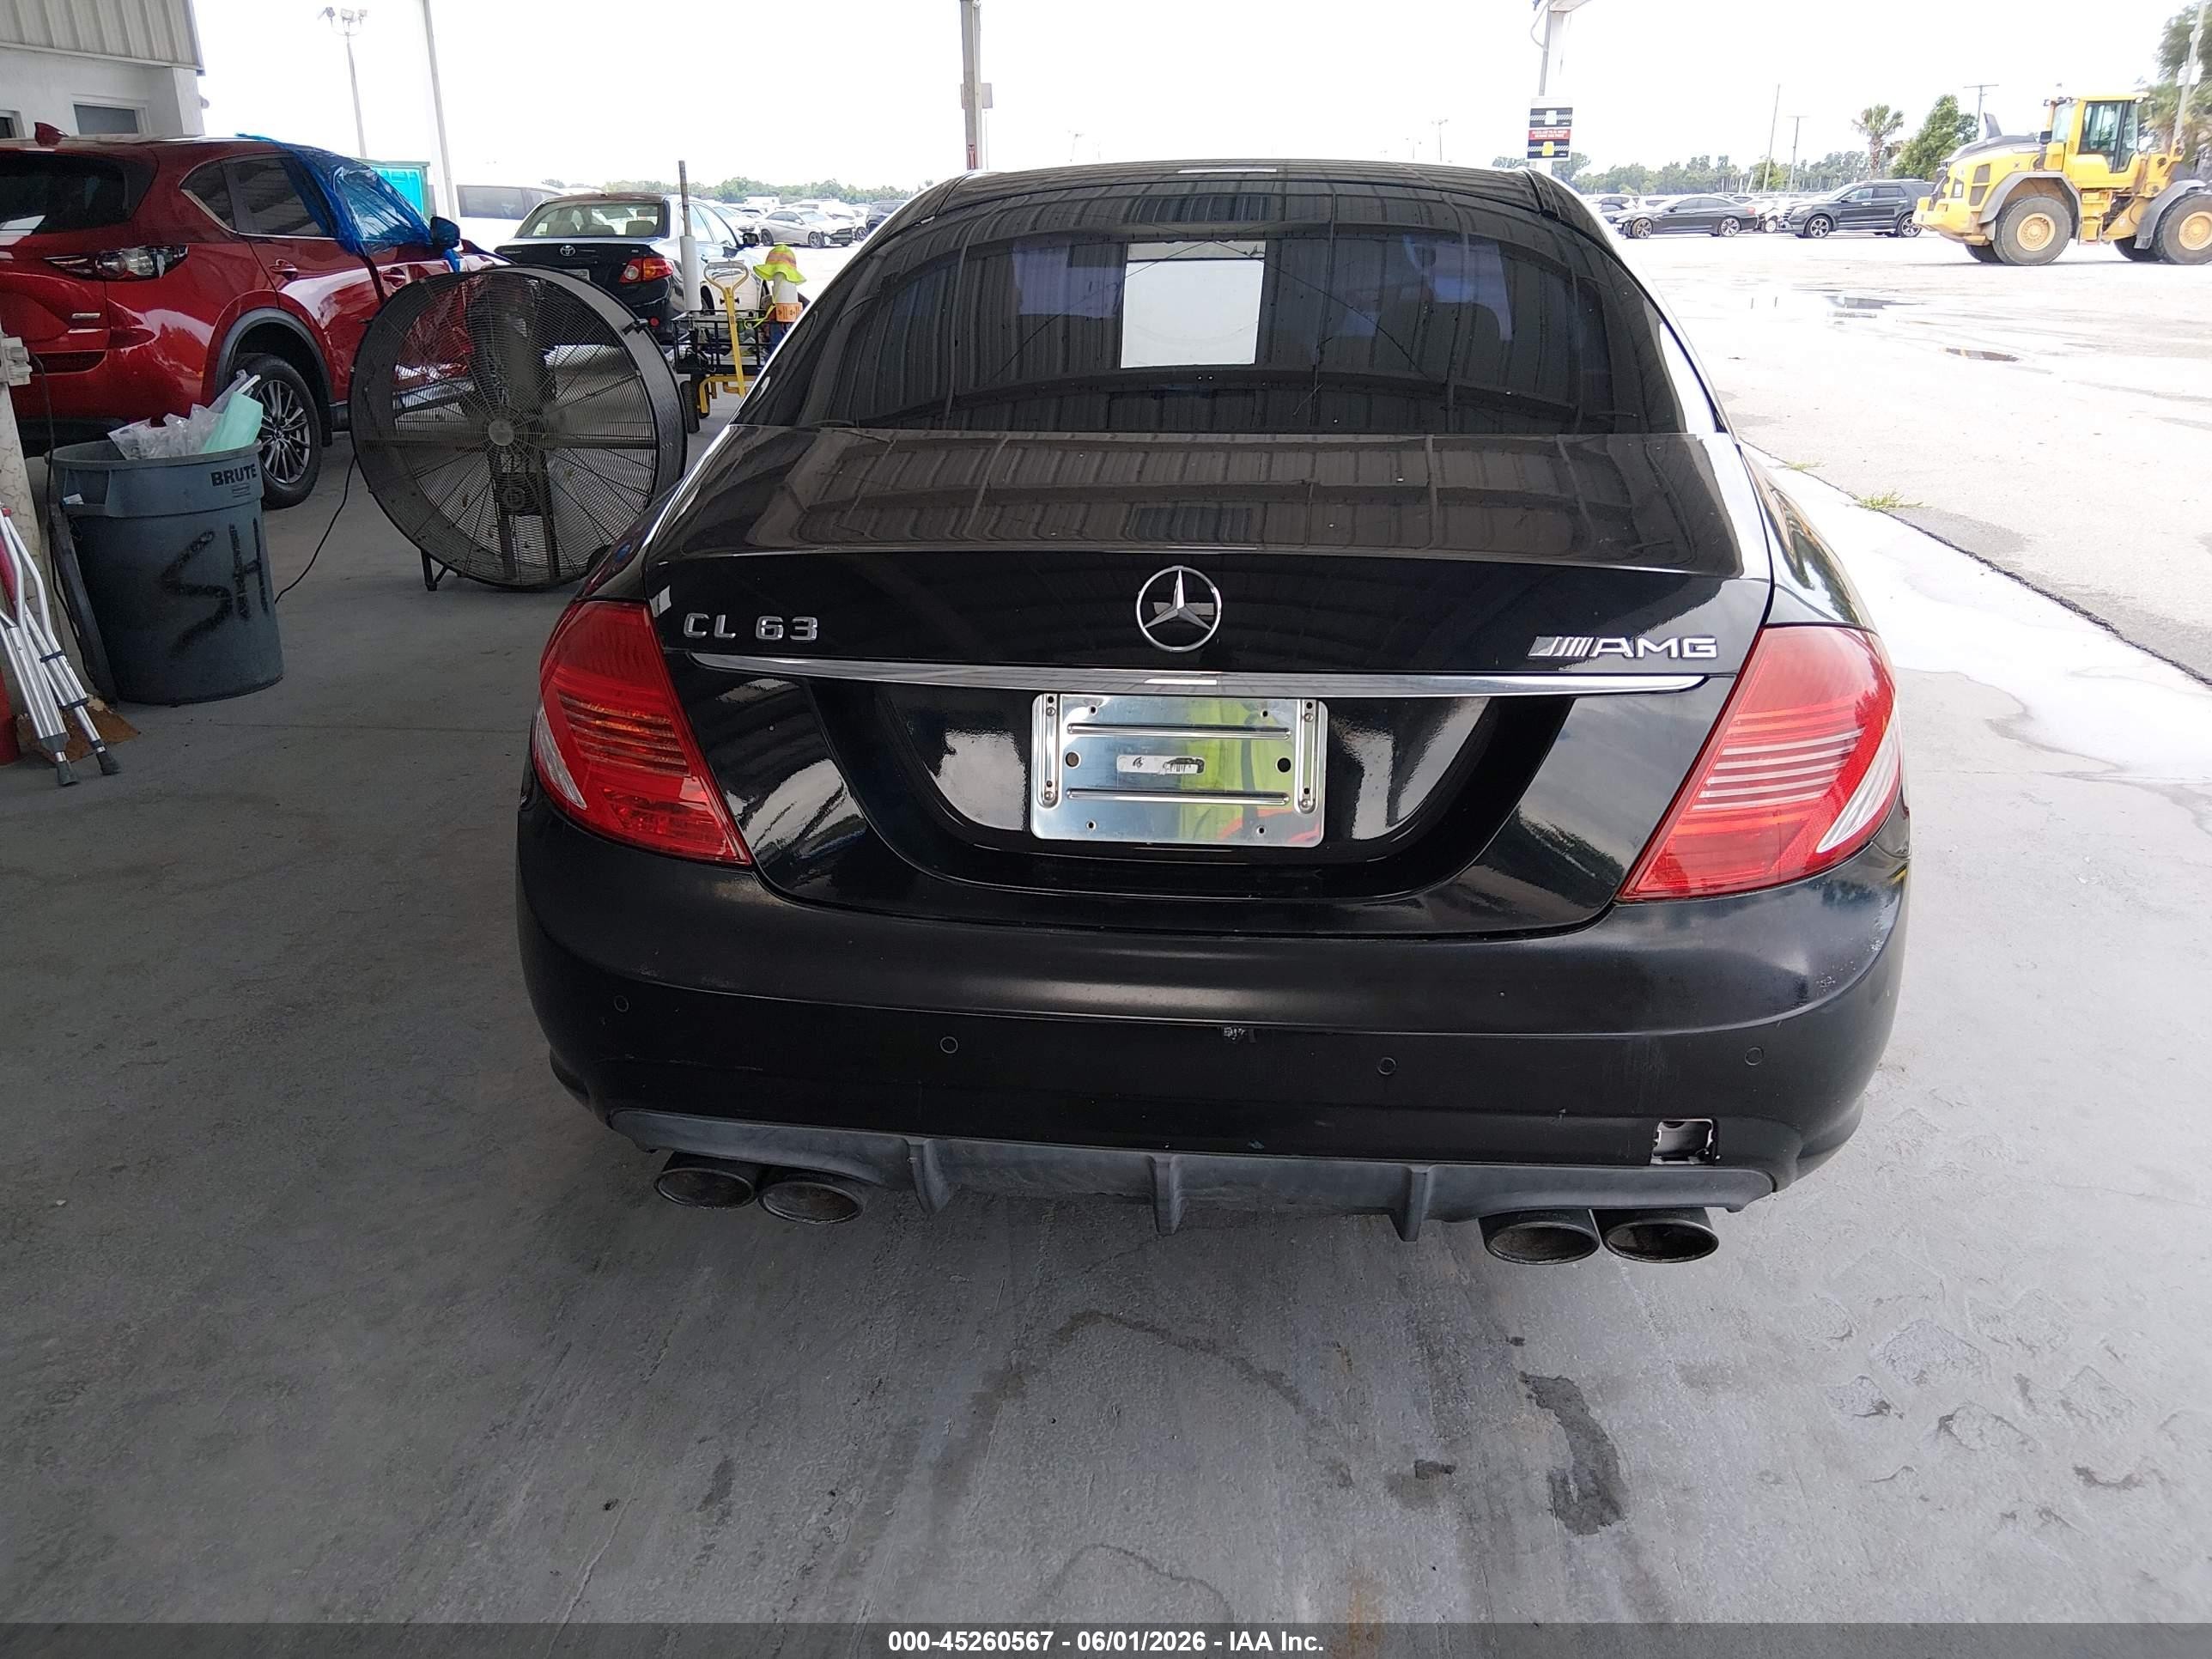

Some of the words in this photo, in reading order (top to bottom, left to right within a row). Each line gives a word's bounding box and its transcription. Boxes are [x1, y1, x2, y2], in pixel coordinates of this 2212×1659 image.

[210, 464, 257, 486] BRUTE
[684, 613, 737, 638] CL
[755, 616, 817, 641] 63
